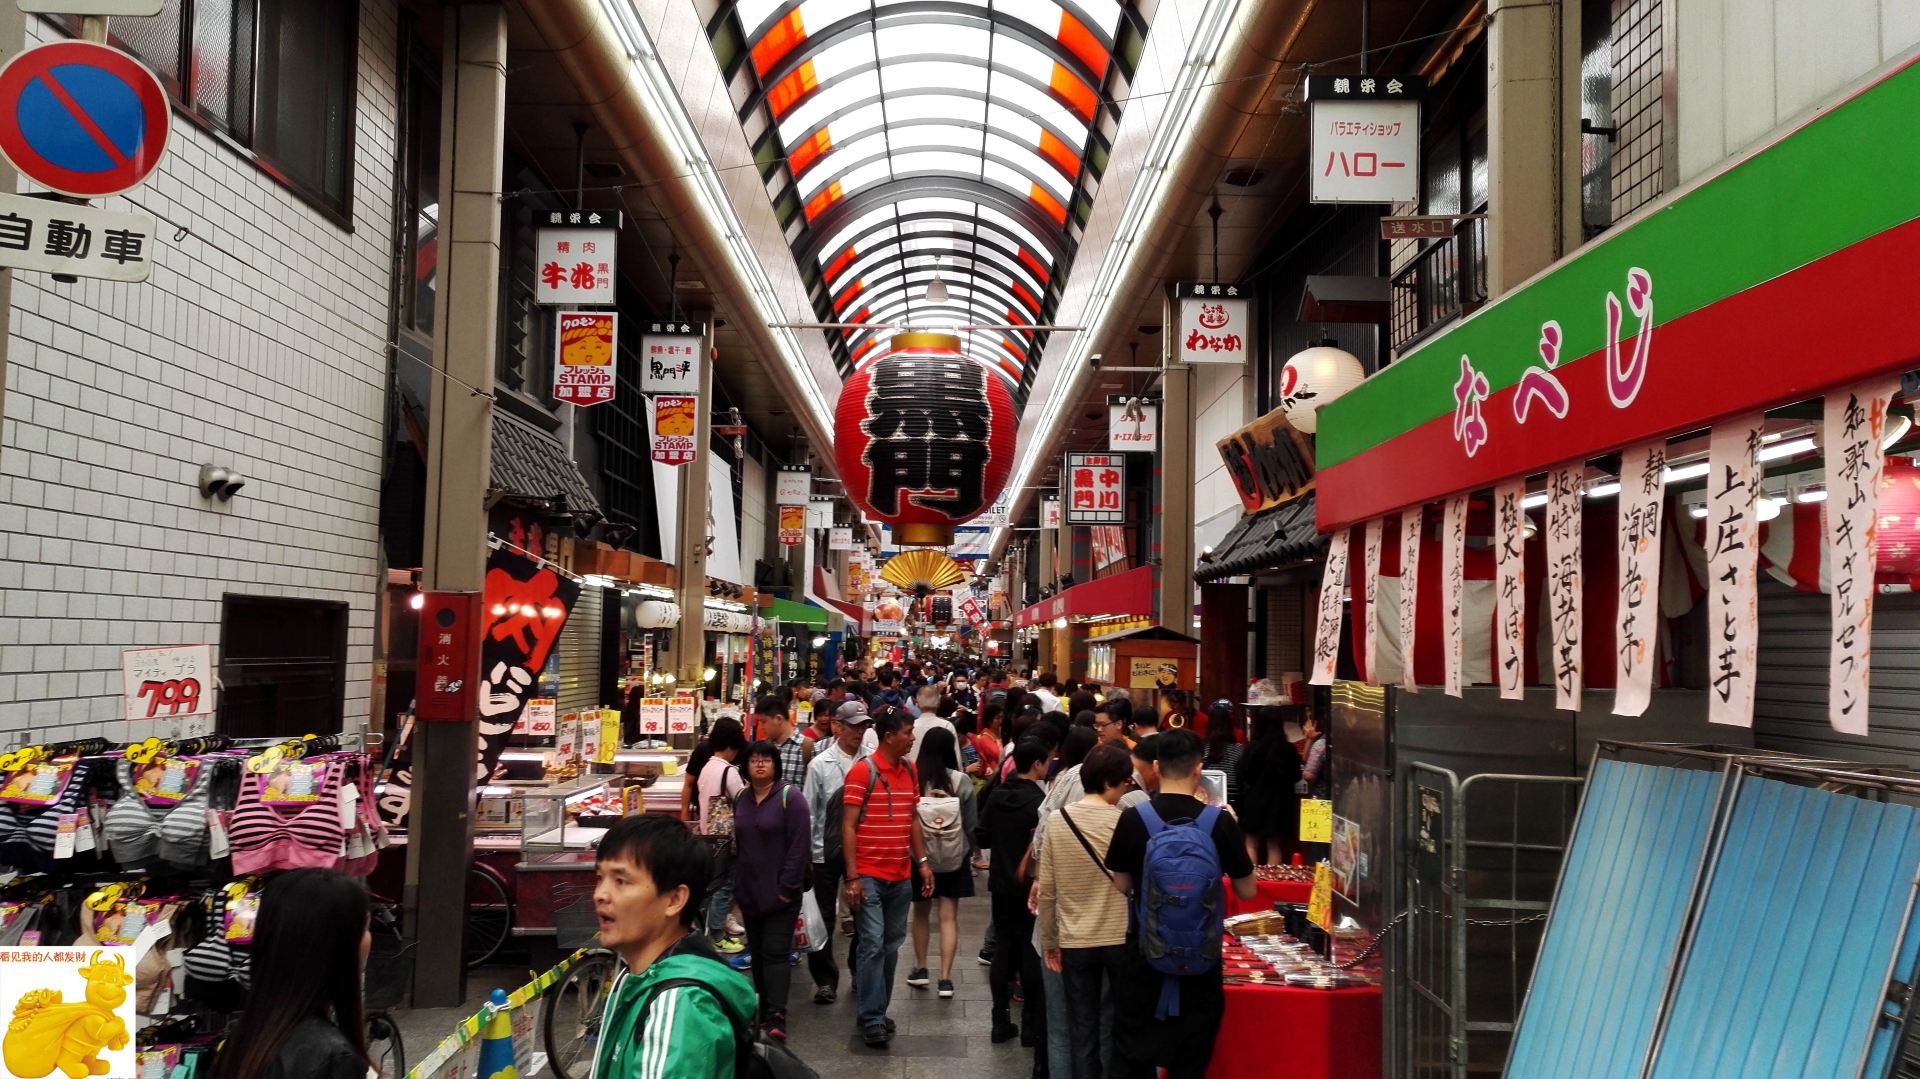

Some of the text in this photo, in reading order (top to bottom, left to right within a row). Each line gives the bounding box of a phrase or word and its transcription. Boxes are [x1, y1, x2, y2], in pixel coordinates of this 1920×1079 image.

[1334, 78, 1403, 94] 親栄会
[1330, 121, 1402, 137] バラエティショップ
[1324, 151, 1406, 178] ハロー
[1391, 220, 1445, 235] 送水口
[0, 212, 146, 265] 自動車
[557, 241, 596, 254] 精肉
[596, 262, 610, 289] 黒門
[1186, 328, 1242, 352] わなか
[563, 365, 606, 375] フレッシュ
[558, 374, 611, 385] STAMP
[558, 386, 611, 398] 加盟店
[654, 442, 694, 450] STAMP
[1074, 468, 1095, 509] 黒門
[1099, 468, 1119, 509] 中川
[434, 633, 452, 692] 消火器
[137, 677, 201, 717] 799
[532, 722, 551, 732] 450
[645, 721, 657, 732] 98
[671, 721, 688, 732] 980
